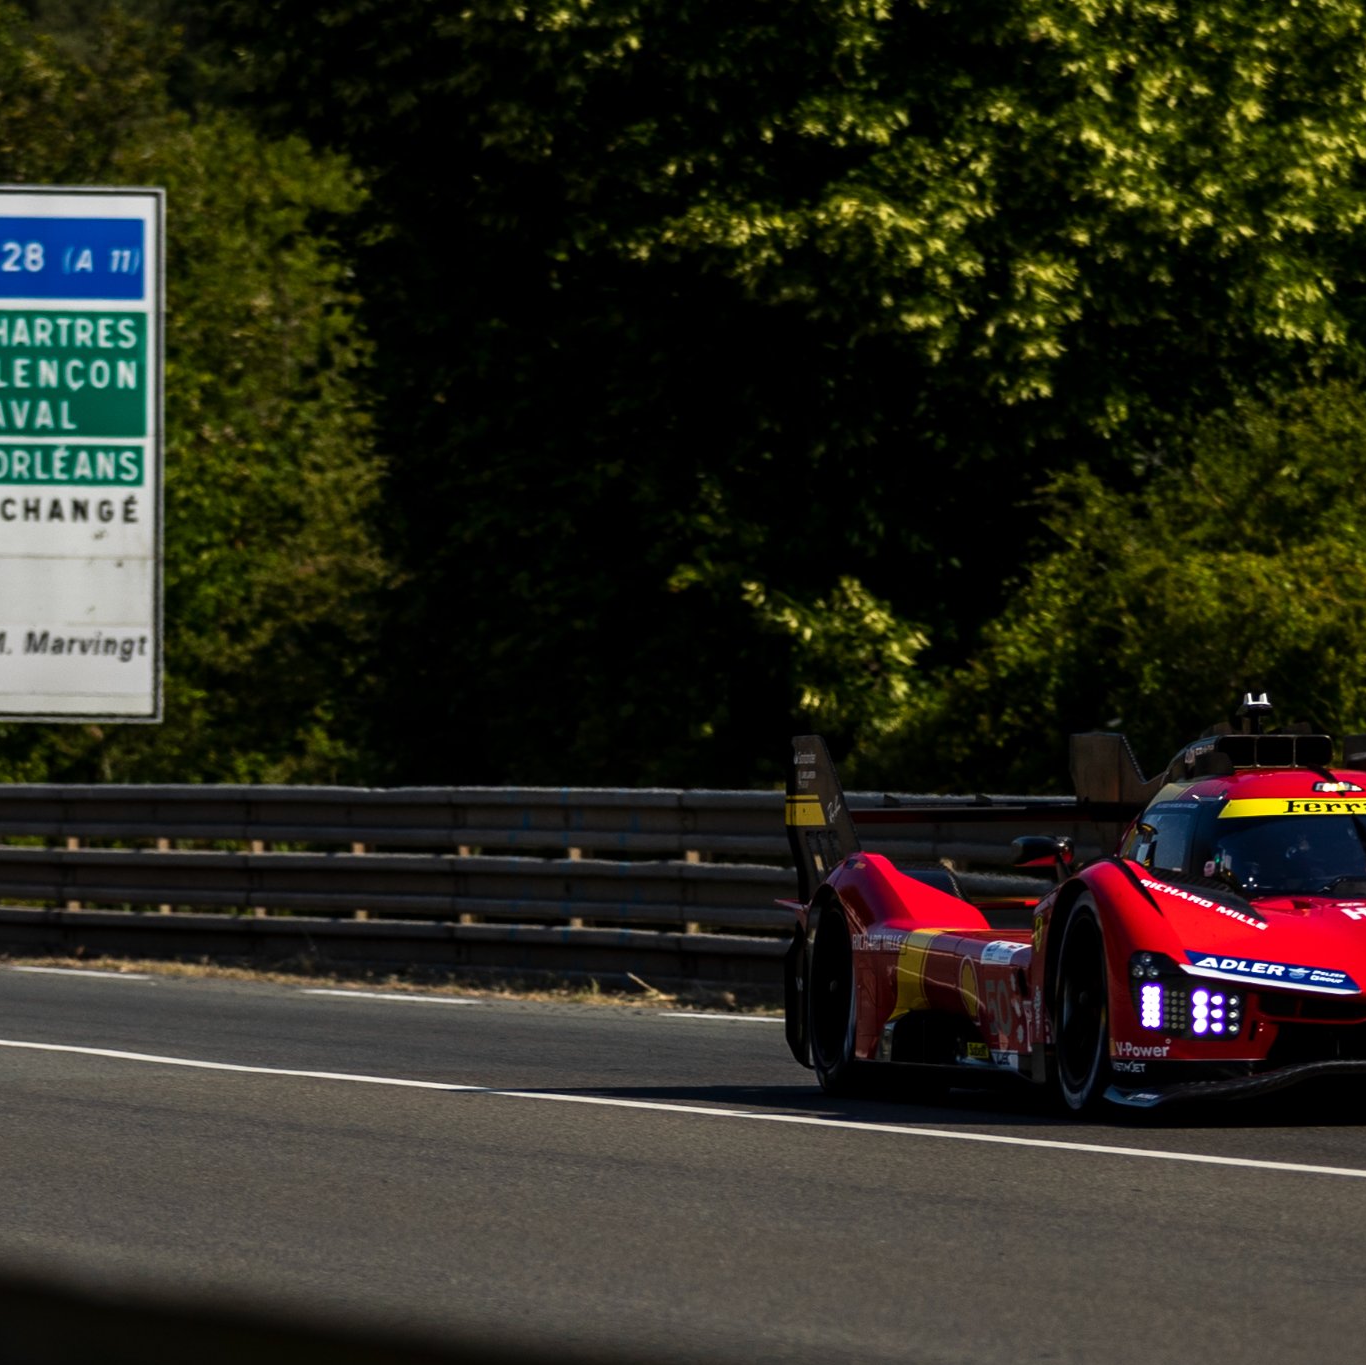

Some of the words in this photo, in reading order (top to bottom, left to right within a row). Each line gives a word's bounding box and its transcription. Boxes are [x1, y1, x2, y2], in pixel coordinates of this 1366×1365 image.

[1, 242, 45, 273] 28
[63, 249, 93, 275] (A
[110, 249, 141, 276] 11)
[0, 495, 139, 524] CHANGÉ
[23, 631, 148, 663] Marvingt
[1140, 879, 1212, 908] RICHARD
[1215, 905, 1269, 931] MILLE
[1195, 957, 1285, 976] ADLER
